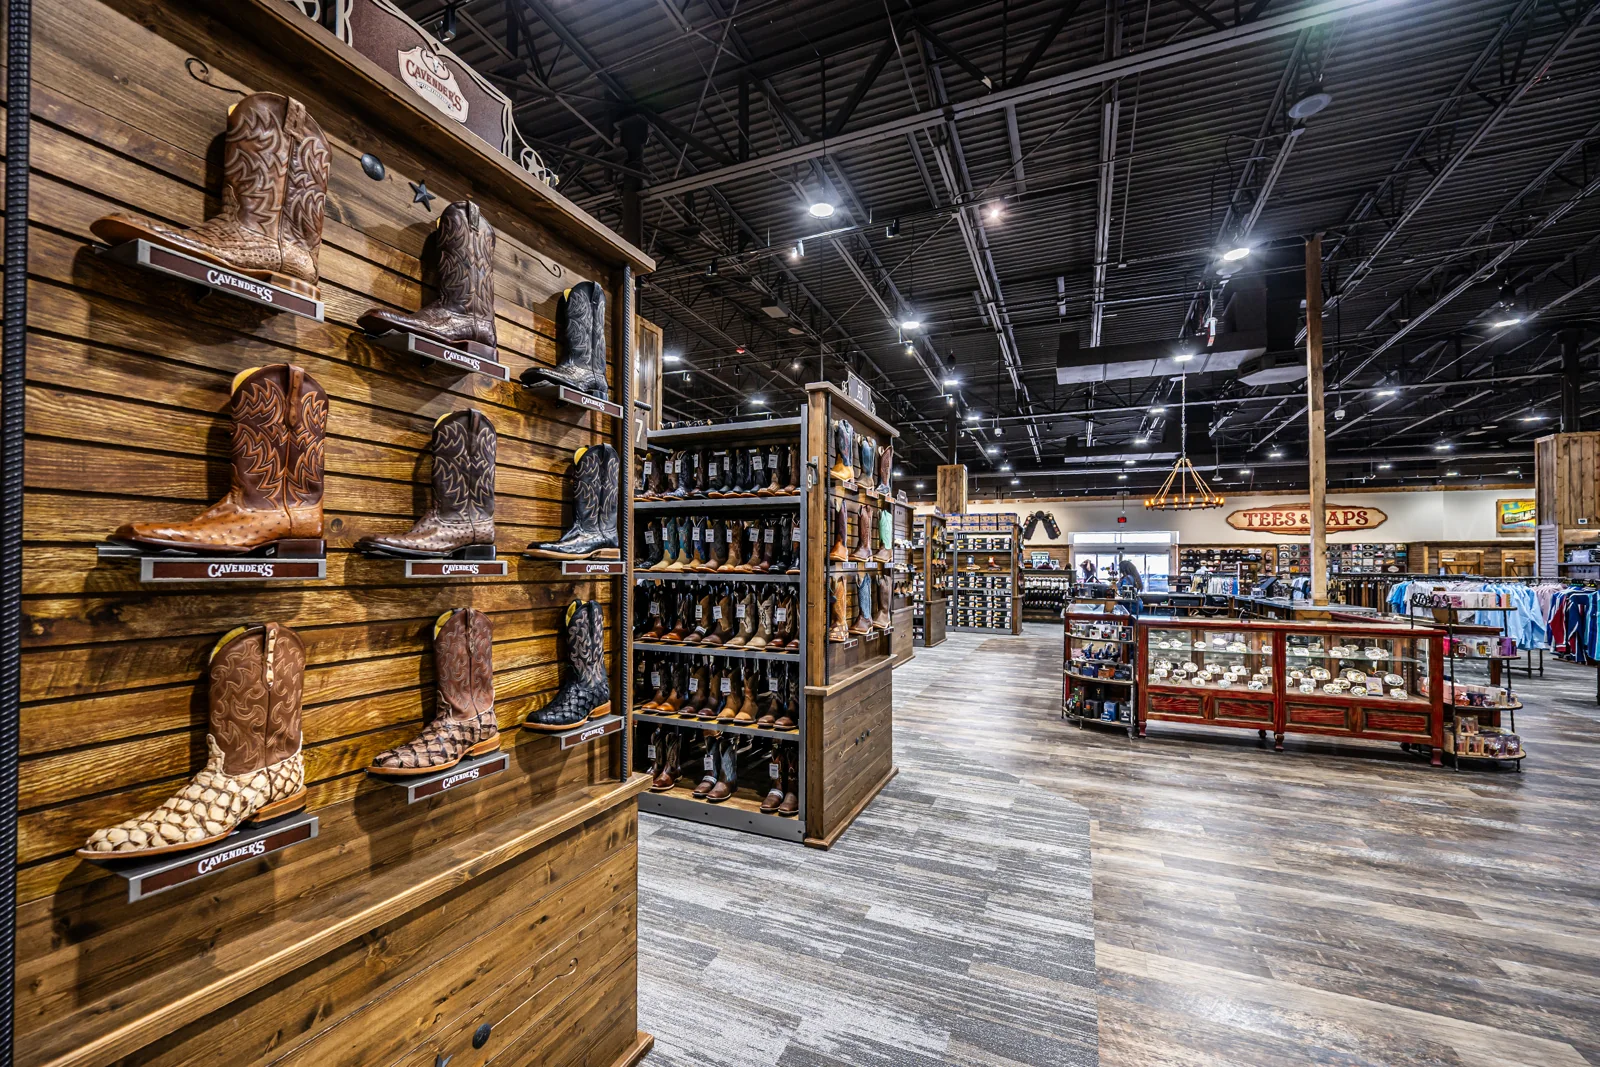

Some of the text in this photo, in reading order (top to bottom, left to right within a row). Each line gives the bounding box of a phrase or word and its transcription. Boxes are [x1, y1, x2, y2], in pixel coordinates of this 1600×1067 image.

[405, 59, 462, 112] CAVENDER'S
[207, 269, 274, 303] CAVENDER'S
[443, 350, 481, 371] CAVENDER'S
[581, 396, 606, 411] CAVENDER'S
[635, 418, 644, 443] 7
[807, 473, 813, 489] 9
[1243, 510, 1369, 527] TEES & APS
[208, 563, 274, 578] CAVENDER'S
[442, 563, 479, 575] CAVENDER'S
[586, 564, 609, 573] CAVENDER'S
[580, 725, 605, 741] CAVENDER'S
[442, 767, 480, 789] CAVENDER'S
[197, 840, 266, 874] CAVENDER'S
